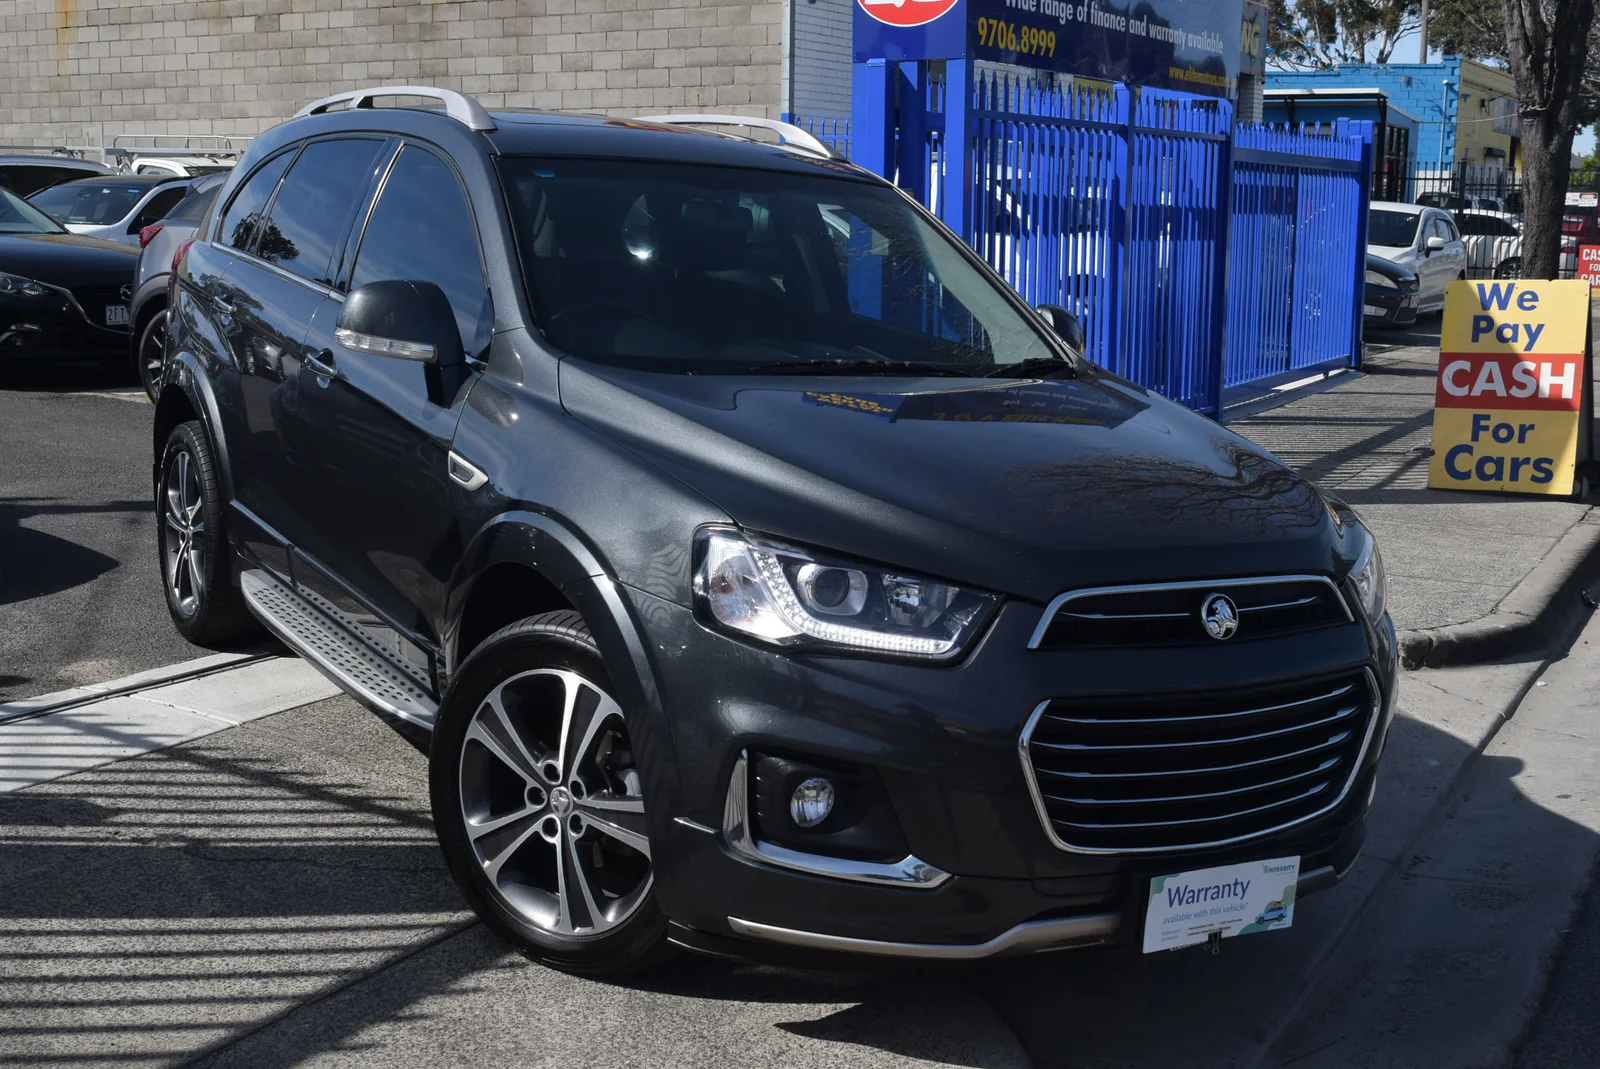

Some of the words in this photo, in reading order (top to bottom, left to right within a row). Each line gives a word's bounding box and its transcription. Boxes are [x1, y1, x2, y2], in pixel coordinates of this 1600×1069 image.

[977, 16, 1056, 58] 9706.8999
[1040, 0, 1074, 25] range
[1076, 0, 1089, 23] of
[1090, 0, 1126, 32] finance
[1129, 15, 1147, 37] and
[1149, 23, 1187, 50] warranty
[1187, 30, 1224, 54] available
[1476, 282, 1540, 311] We
[1471, 314, 1545, 352] Pay
[1441, 359, 1576, 399] CASH
[1470, 413, 1536, 444] For
[1444, 444, 1555, 484] Cars
[1167, 878, 1251, 908] Warranty
[1163, 911, 1193, 925] available
[1193, 907, 1209, 918] with
[1209, 905, 1222, 917] this
